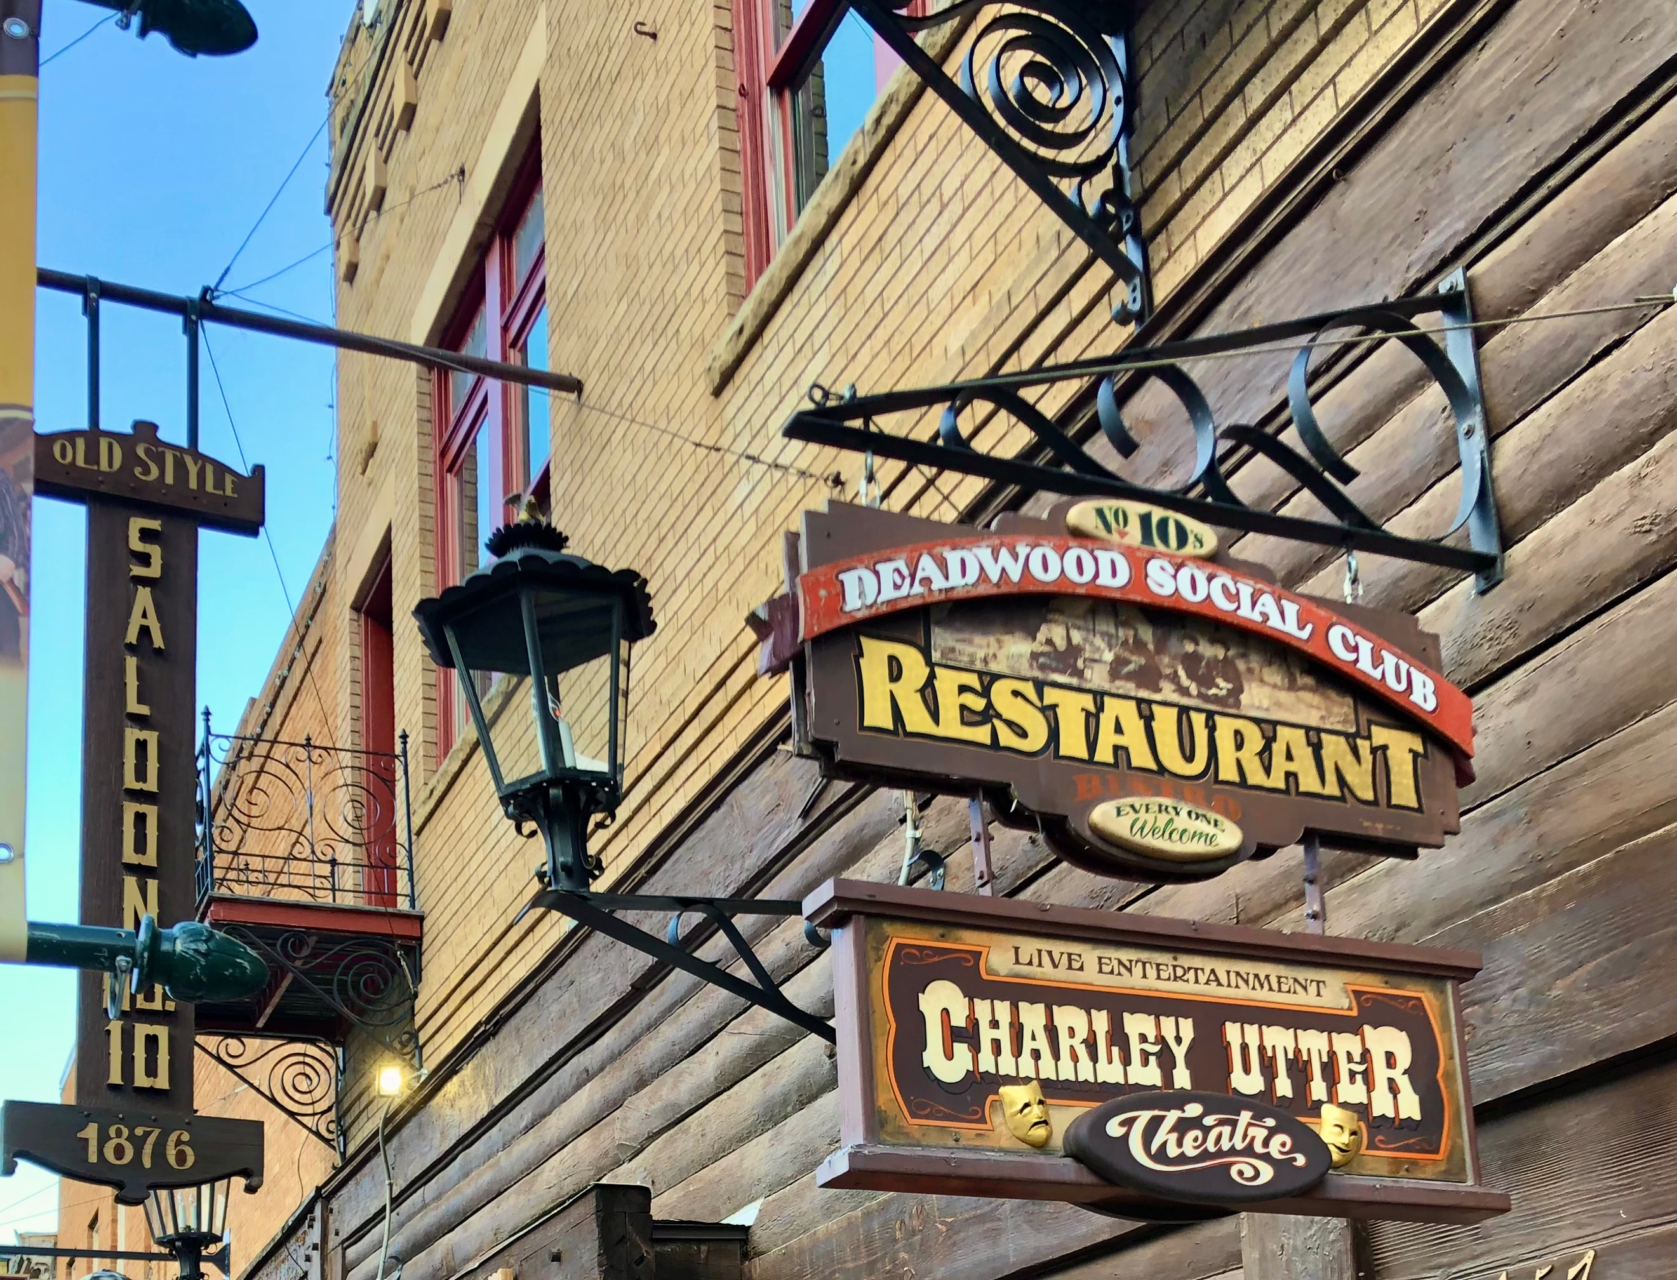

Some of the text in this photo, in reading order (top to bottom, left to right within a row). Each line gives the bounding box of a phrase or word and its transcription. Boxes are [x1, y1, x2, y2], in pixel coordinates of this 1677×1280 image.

[53, 439, 239, 499] OLD STYLE
[838, 544, 1439, 715] DEADWOOD SOCIAL CLUB
[123, 516, 165, 930] SALOON
[858, 635, 1427, 810] RESTAURANT
[1115, 802, 1226, 832] EVERY ONE
[1129, 815, 1220, 848] Welcome
[1011, 946, 1328, 999] LIVE ENTERTAINMENT
[104, 1020, 171, 1090] 10
[917, 979, 1422, 1122] CHARLEY UTTER
[76, 1121, 196, 1170] 1876
[1105, 1102, 1306, 1187] Theatre
